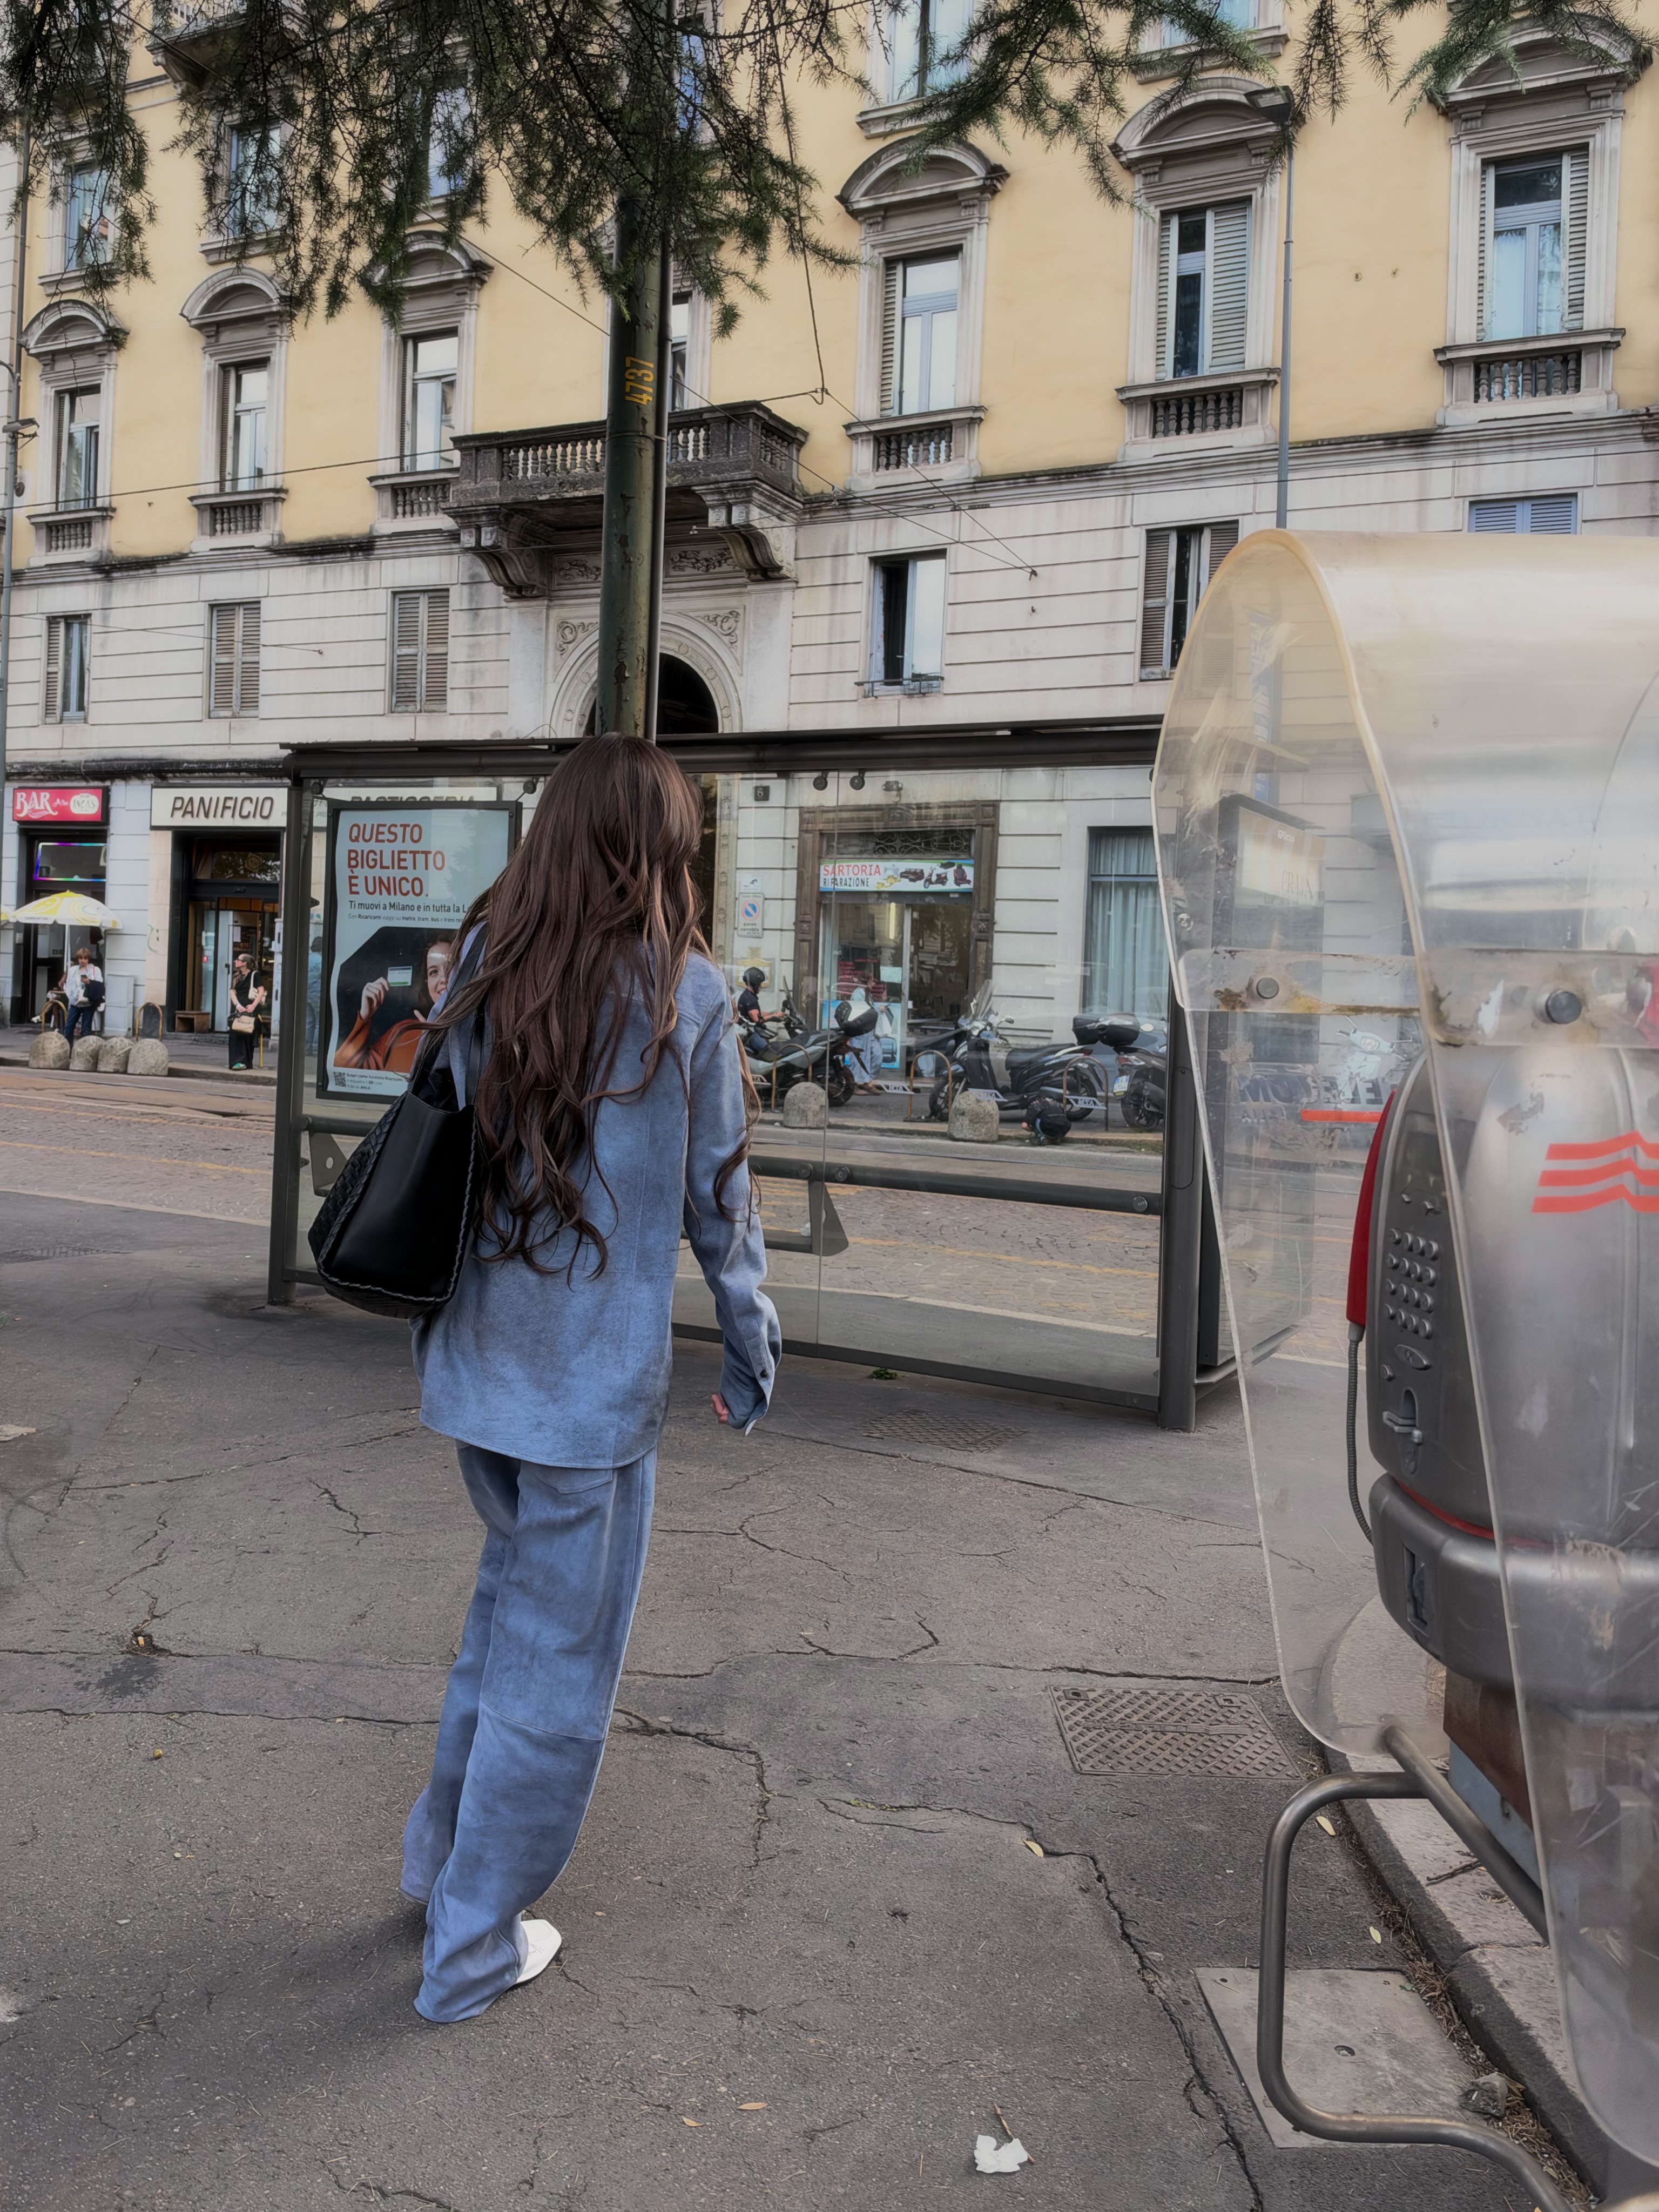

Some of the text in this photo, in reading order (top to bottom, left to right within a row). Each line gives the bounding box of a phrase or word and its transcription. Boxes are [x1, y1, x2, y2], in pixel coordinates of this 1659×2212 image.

[625, 356, 654, 406] 4737
[757, 788, 763, 798] 6
[16, 791, 58, 818] BAR
[73, 799, 96, 809] INCAS
[170, 797, 274, 819] PANIFICIO
[349, 823, 423, 844] QUESTO
[347, 849, 446, 871] BIGLIETTO
[823, 864, 881, 876] SARTORIA
[348, 869, 429, 897] È UNICO.
[349, 900, 356, 909] Ti
[358, 901, 381, 910] muovi
[389, 901, 415, 912] Milano
[423, 903, 430, 912] in
[433, 904, 451, 913] tutta
[453, 903, 460, 913] la
